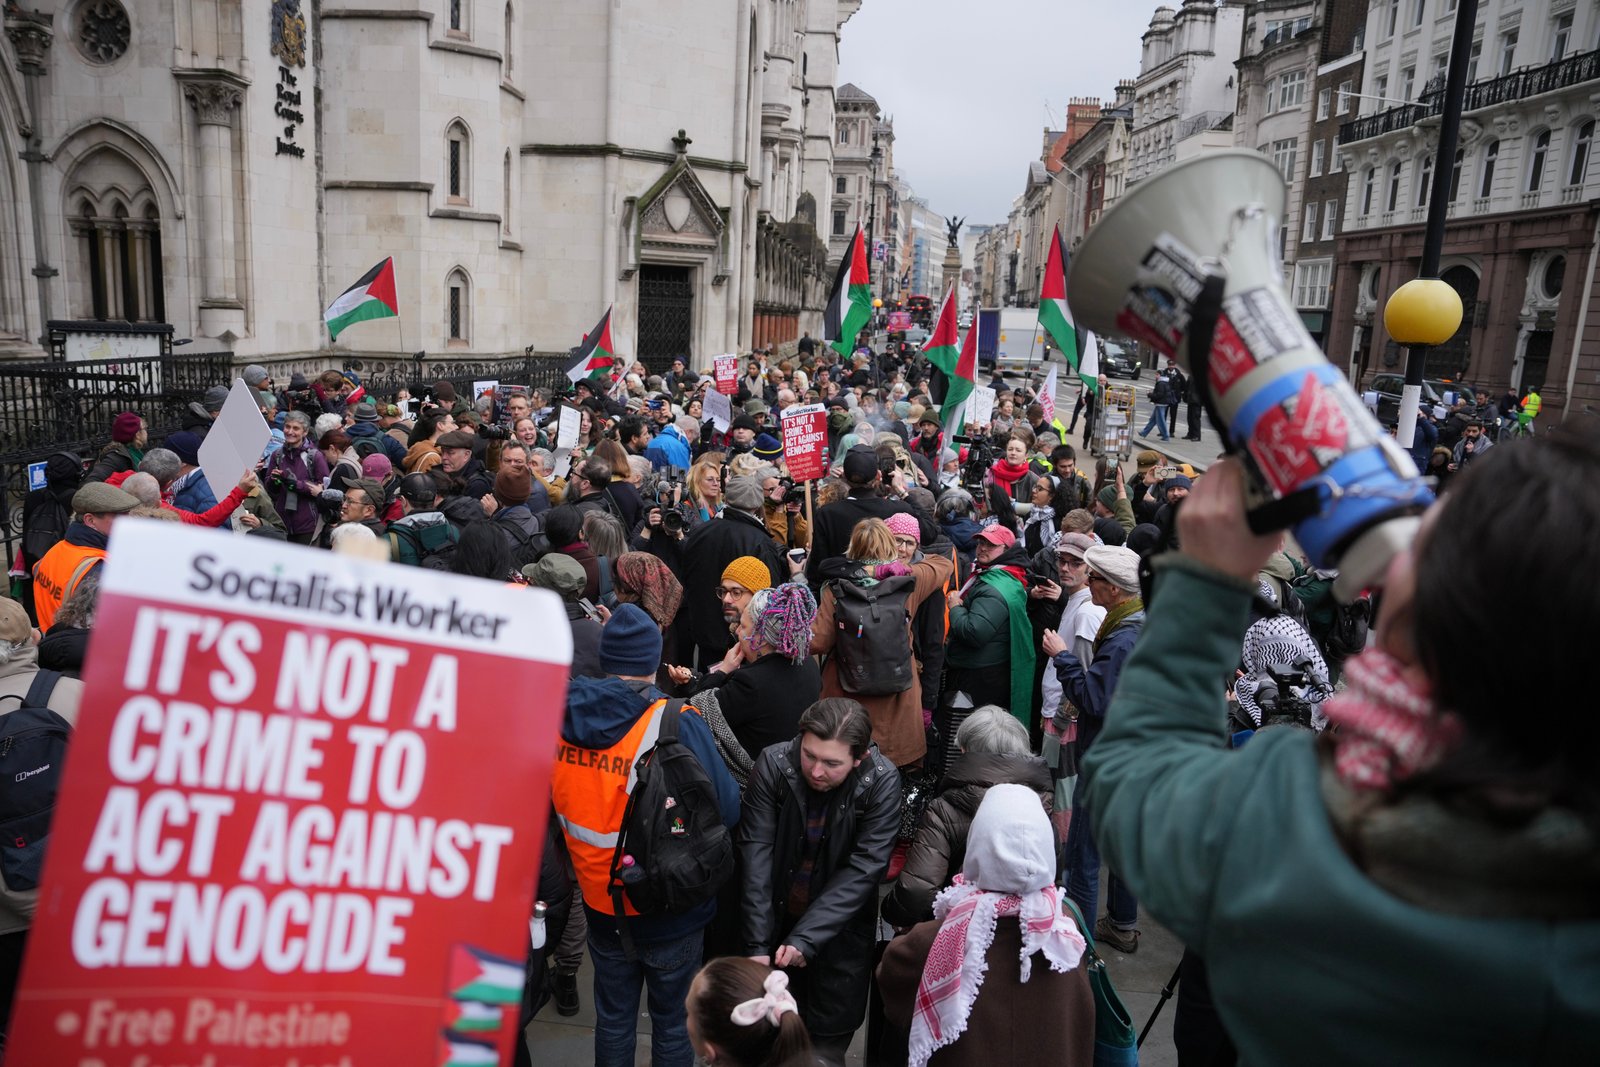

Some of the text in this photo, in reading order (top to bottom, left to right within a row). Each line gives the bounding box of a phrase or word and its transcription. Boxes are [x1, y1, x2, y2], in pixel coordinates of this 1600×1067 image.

[279, 65, 297, 87] The
[276, 83, 301, 106] Royal
[274, 101, 304, 124] Courts
[284, 123, 296, 138] of
[275, 136, 305, 158] Justice
[784, 414, 815, 429] IT'S NOT A
[785, 424, 813, 438] CRIME TO
[786, 432, 824, 448] ACT AGAINST
[786, 443, 816, 457] GENOCIDE
[124, 605, 458, 732] IT'S NOT A
[108, 694, 427, 810] CRIME TO
[83, 785, 515, 902] ACT AGAINST
[70, 876, 414, 977] GENOCIDE
[83, 998, 350, 1049] Free Palestine
